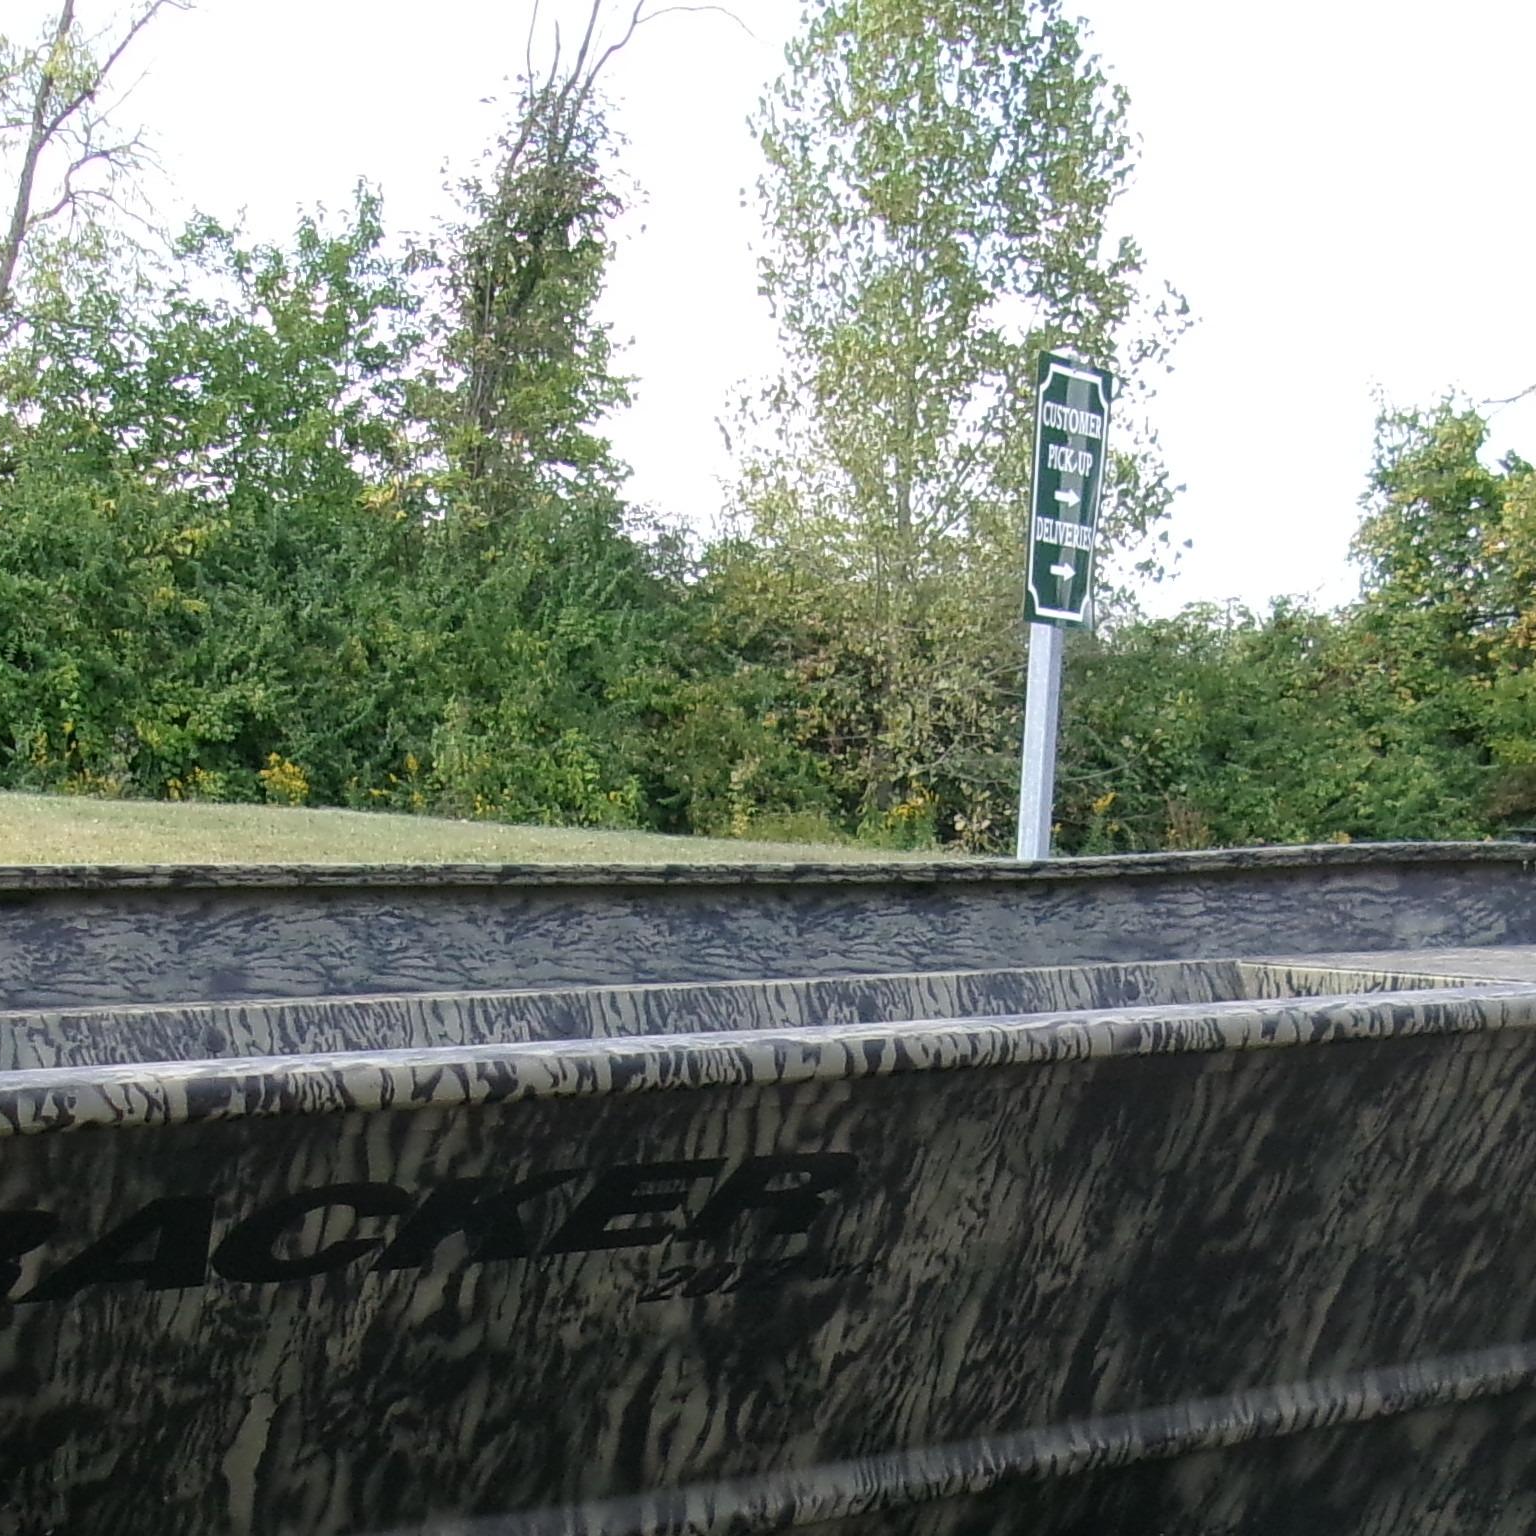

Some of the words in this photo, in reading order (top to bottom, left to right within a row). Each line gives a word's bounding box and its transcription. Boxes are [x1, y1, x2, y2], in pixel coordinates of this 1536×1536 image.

[1043, 401, 1102, 439] CUSTOMER
[1047, 443, 1093, 477] PICK-UP
[1036, 516, 1092, 552] DELIVERIES
